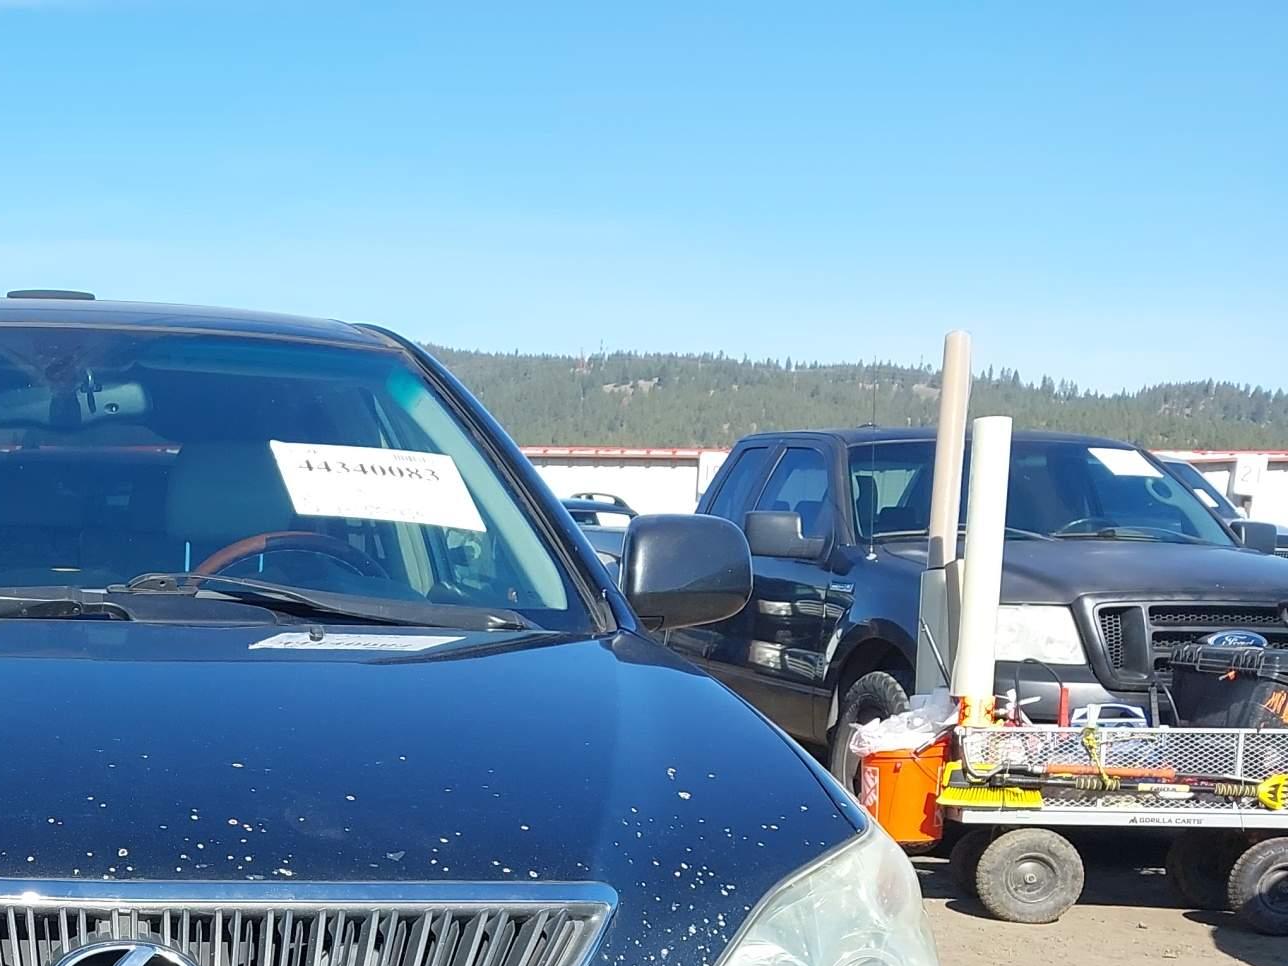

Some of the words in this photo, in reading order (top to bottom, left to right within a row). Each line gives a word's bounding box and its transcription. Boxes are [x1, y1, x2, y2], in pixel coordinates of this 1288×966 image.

[298, 459, 441, 481] 44340083
[1239, 464, 1261, 484] 21
[1222, 634, 1255, 646] Ford
[1139, 816, 1173, 824] GORILLA
